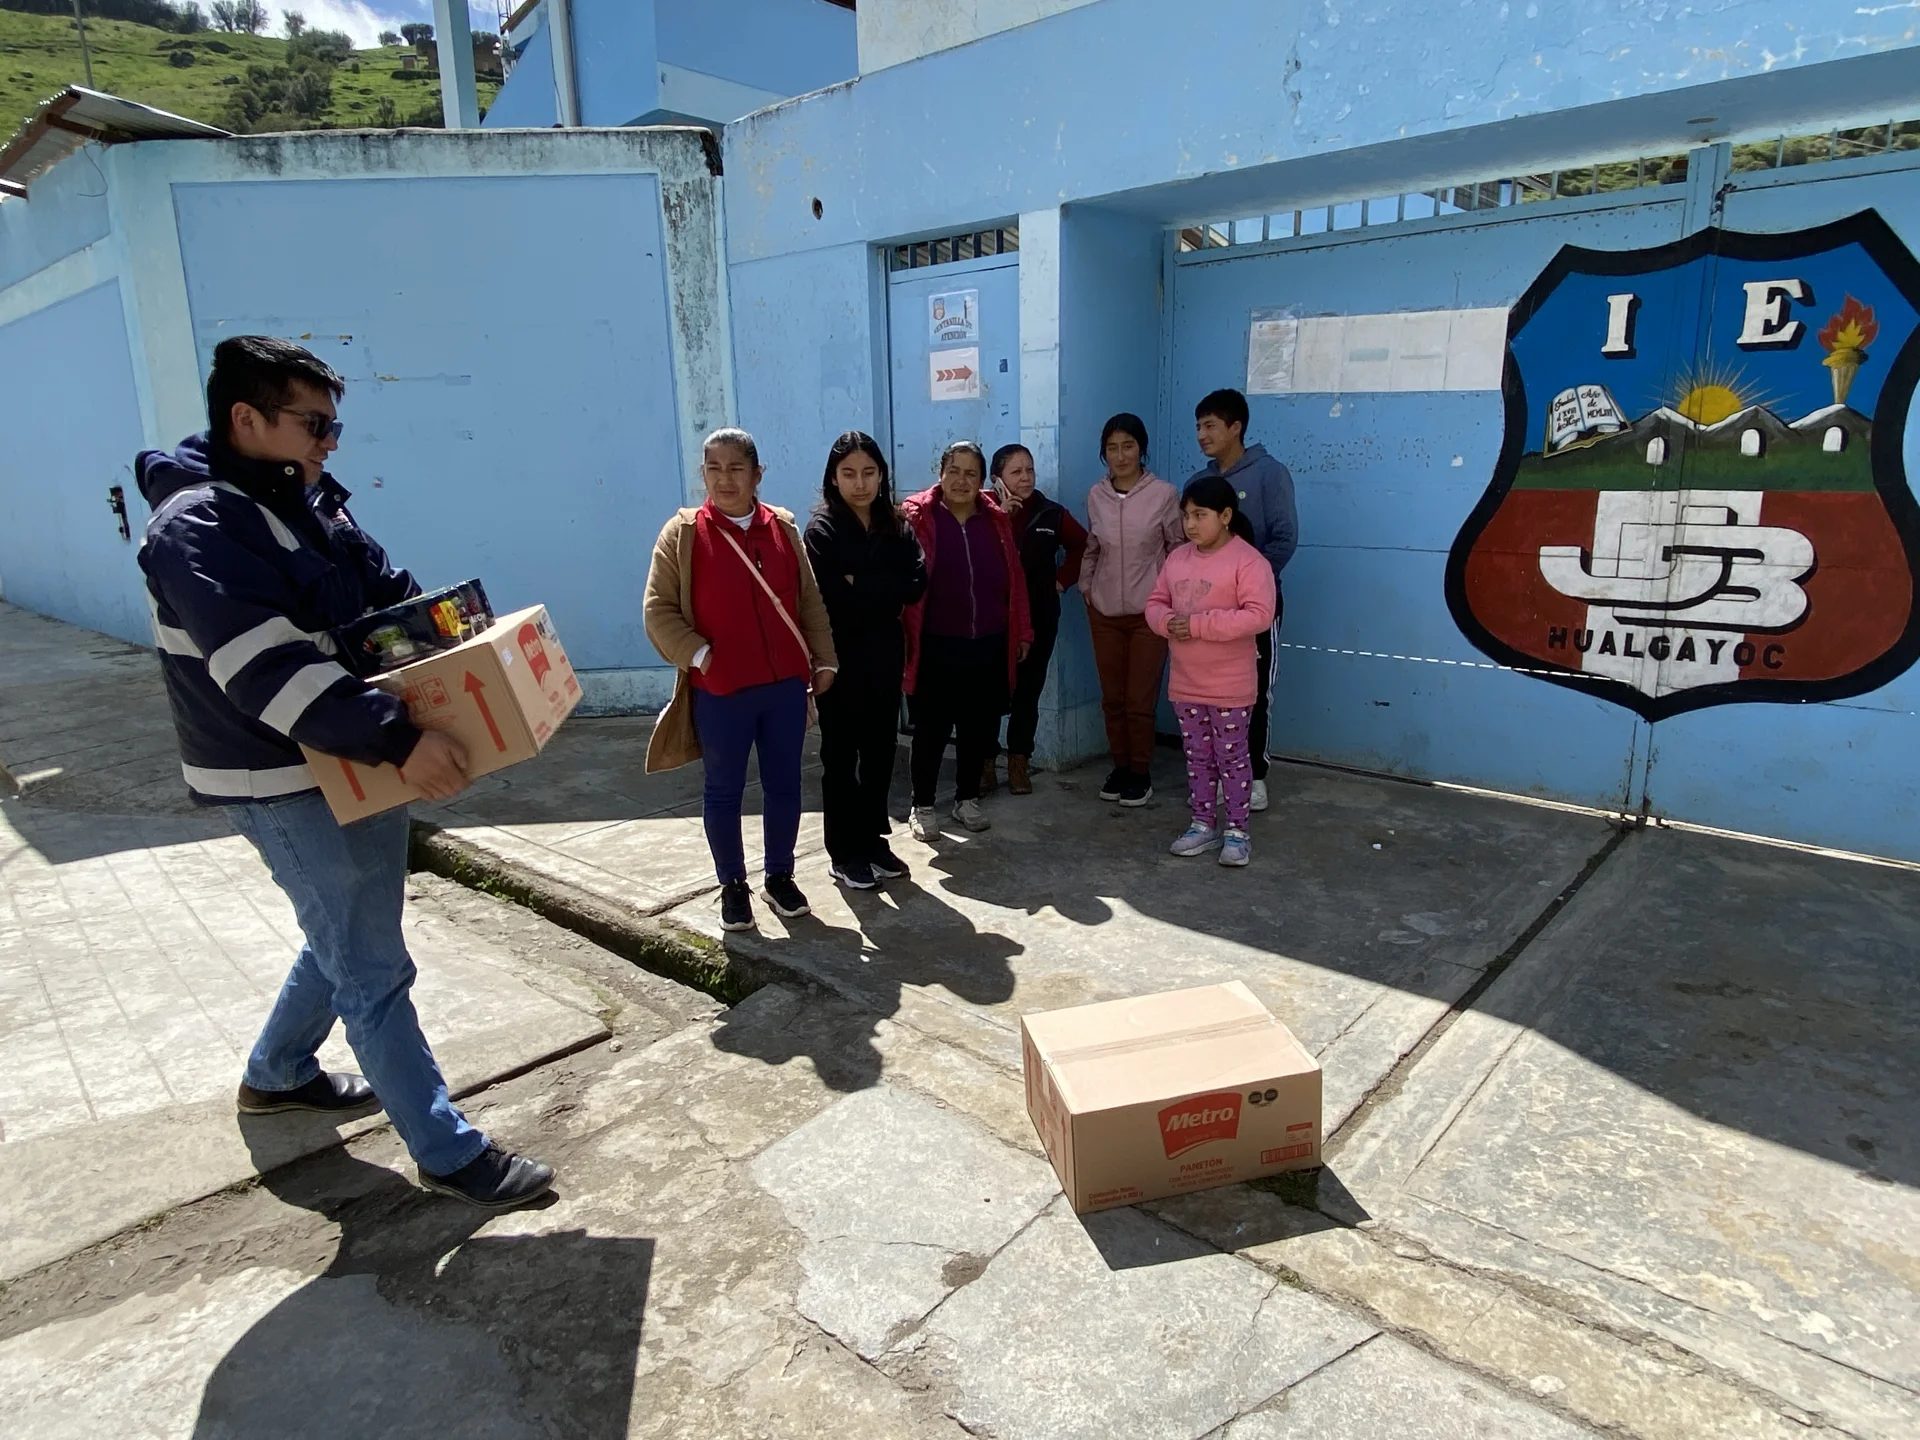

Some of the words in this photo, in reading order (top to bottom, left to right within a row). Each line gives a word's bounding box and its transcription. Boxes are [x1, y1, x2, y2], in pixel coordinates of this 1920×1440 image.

[1601, 293, 1639, 356] I
[1736, 279, 1808, 348] E
[1548, 626, 1786, 669] HUALGAYOC
[1165, 1107, 1234, 1132] Metro
